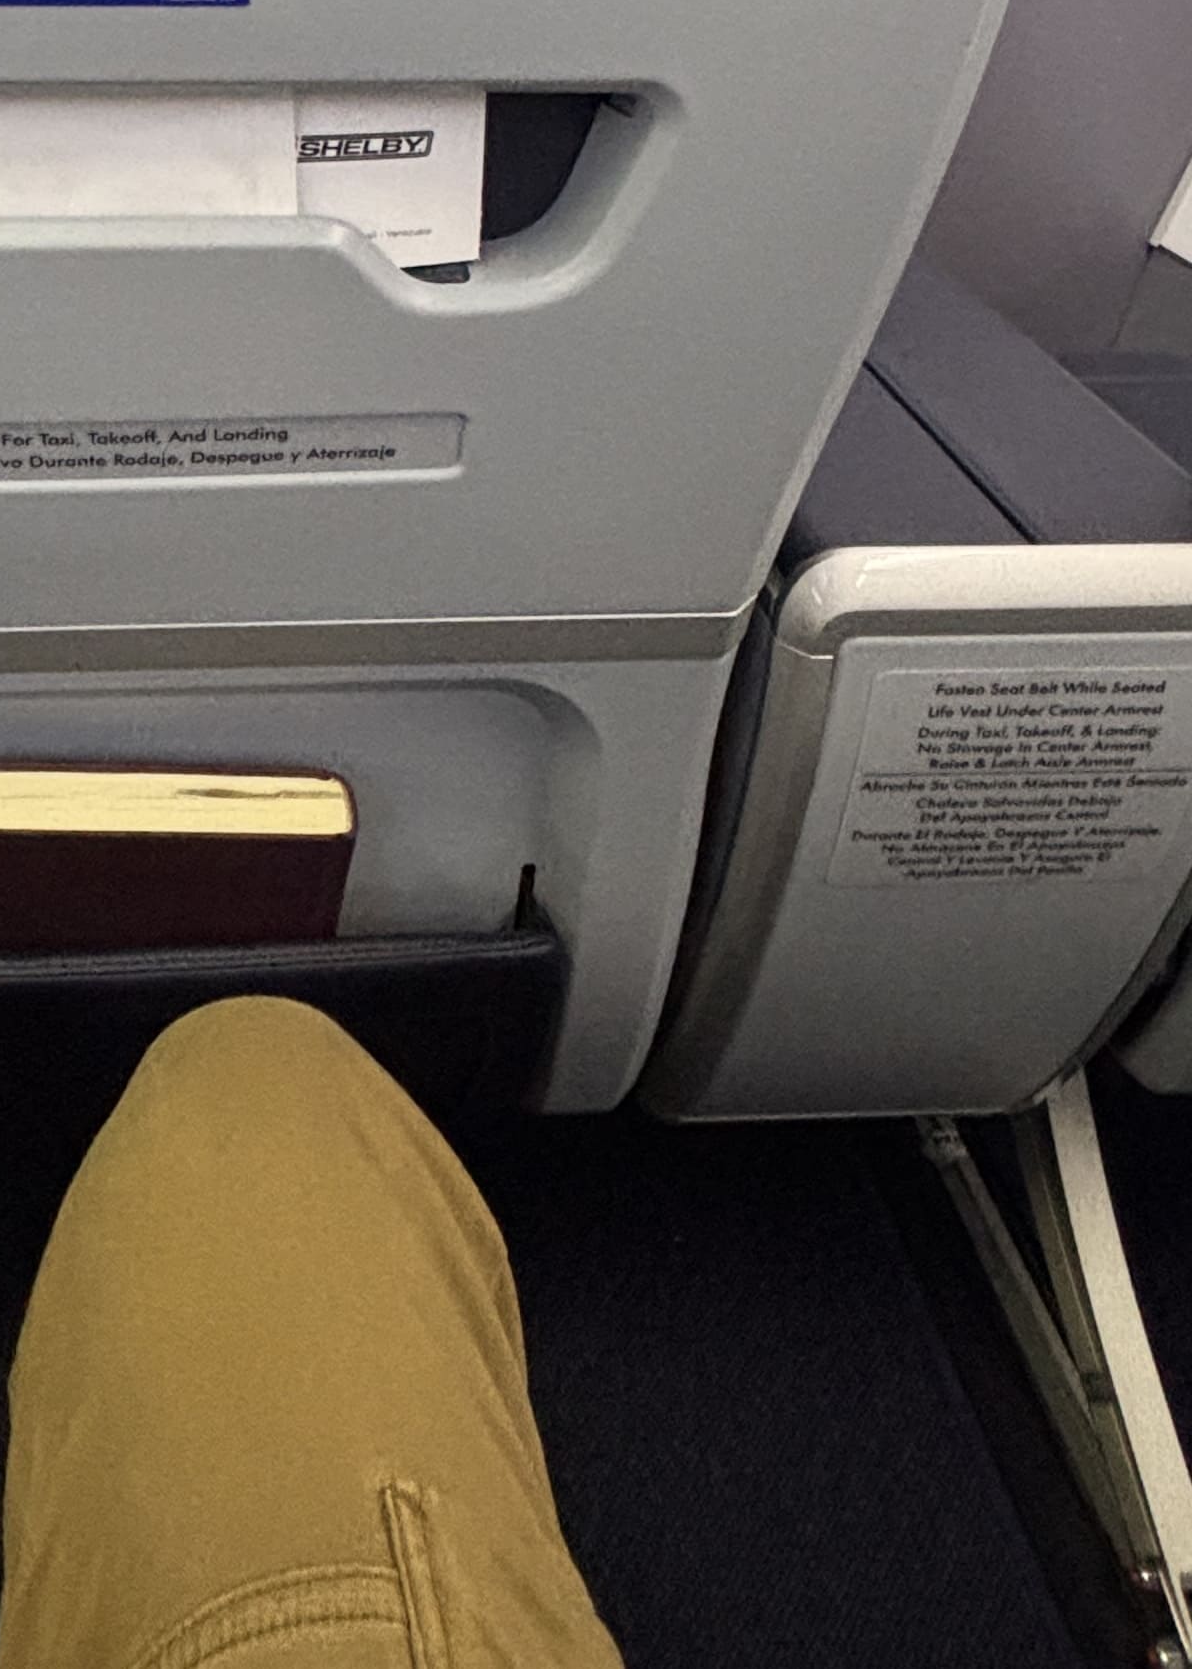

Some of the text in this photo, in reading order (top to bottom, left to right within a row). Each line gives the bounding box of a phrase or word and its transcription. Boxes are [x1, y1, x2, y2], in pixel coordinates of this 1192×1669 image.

[298, 135, 426, 157] SHELBY
[2, 433, 30, 447] For
[41, 432, 79, 448] Taxi,
[91, 430, 161, 446] Takeoff,
[170, 430, 207, 443] And
[215, 428, 287, 443] Landing
[30, 455, 106, 468] Durante
[114, 453, 183, 468] Rodaje,
[191, 452, 284, 467] Despegue
[290, 452, 301, 463] y
[307, 447, 396, 461] Aterrizaje
[936, 681, 1166, 696] Fasten Seat Belt While Seated
[1049, 705, 1100, 716] Center
